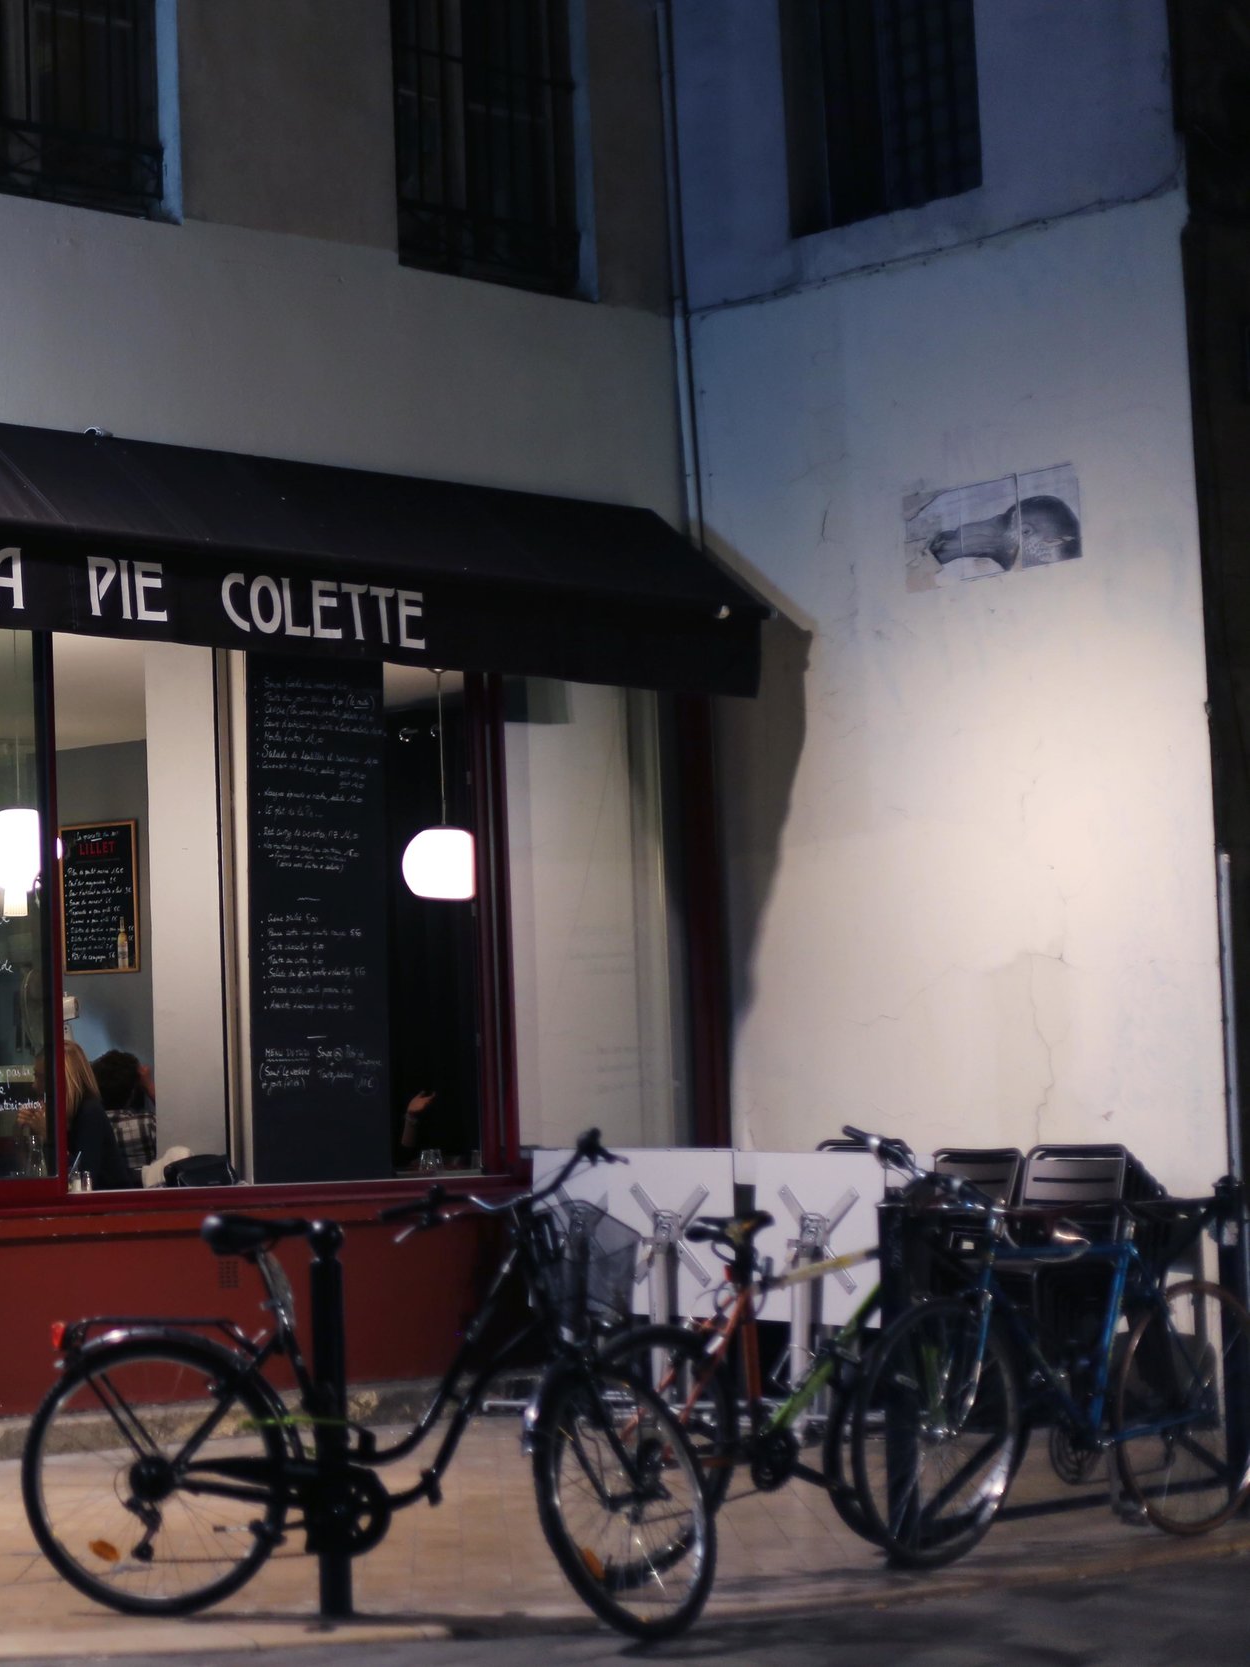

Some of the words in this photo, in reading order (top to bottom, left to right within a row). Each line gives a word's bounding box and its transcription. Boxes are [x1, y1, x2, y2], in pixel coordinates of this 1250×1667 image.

[86, 556, 168, 622] PIE
[221, 572, 426, 650] COLETTE
[78, 841, 117, 857] LILLET
